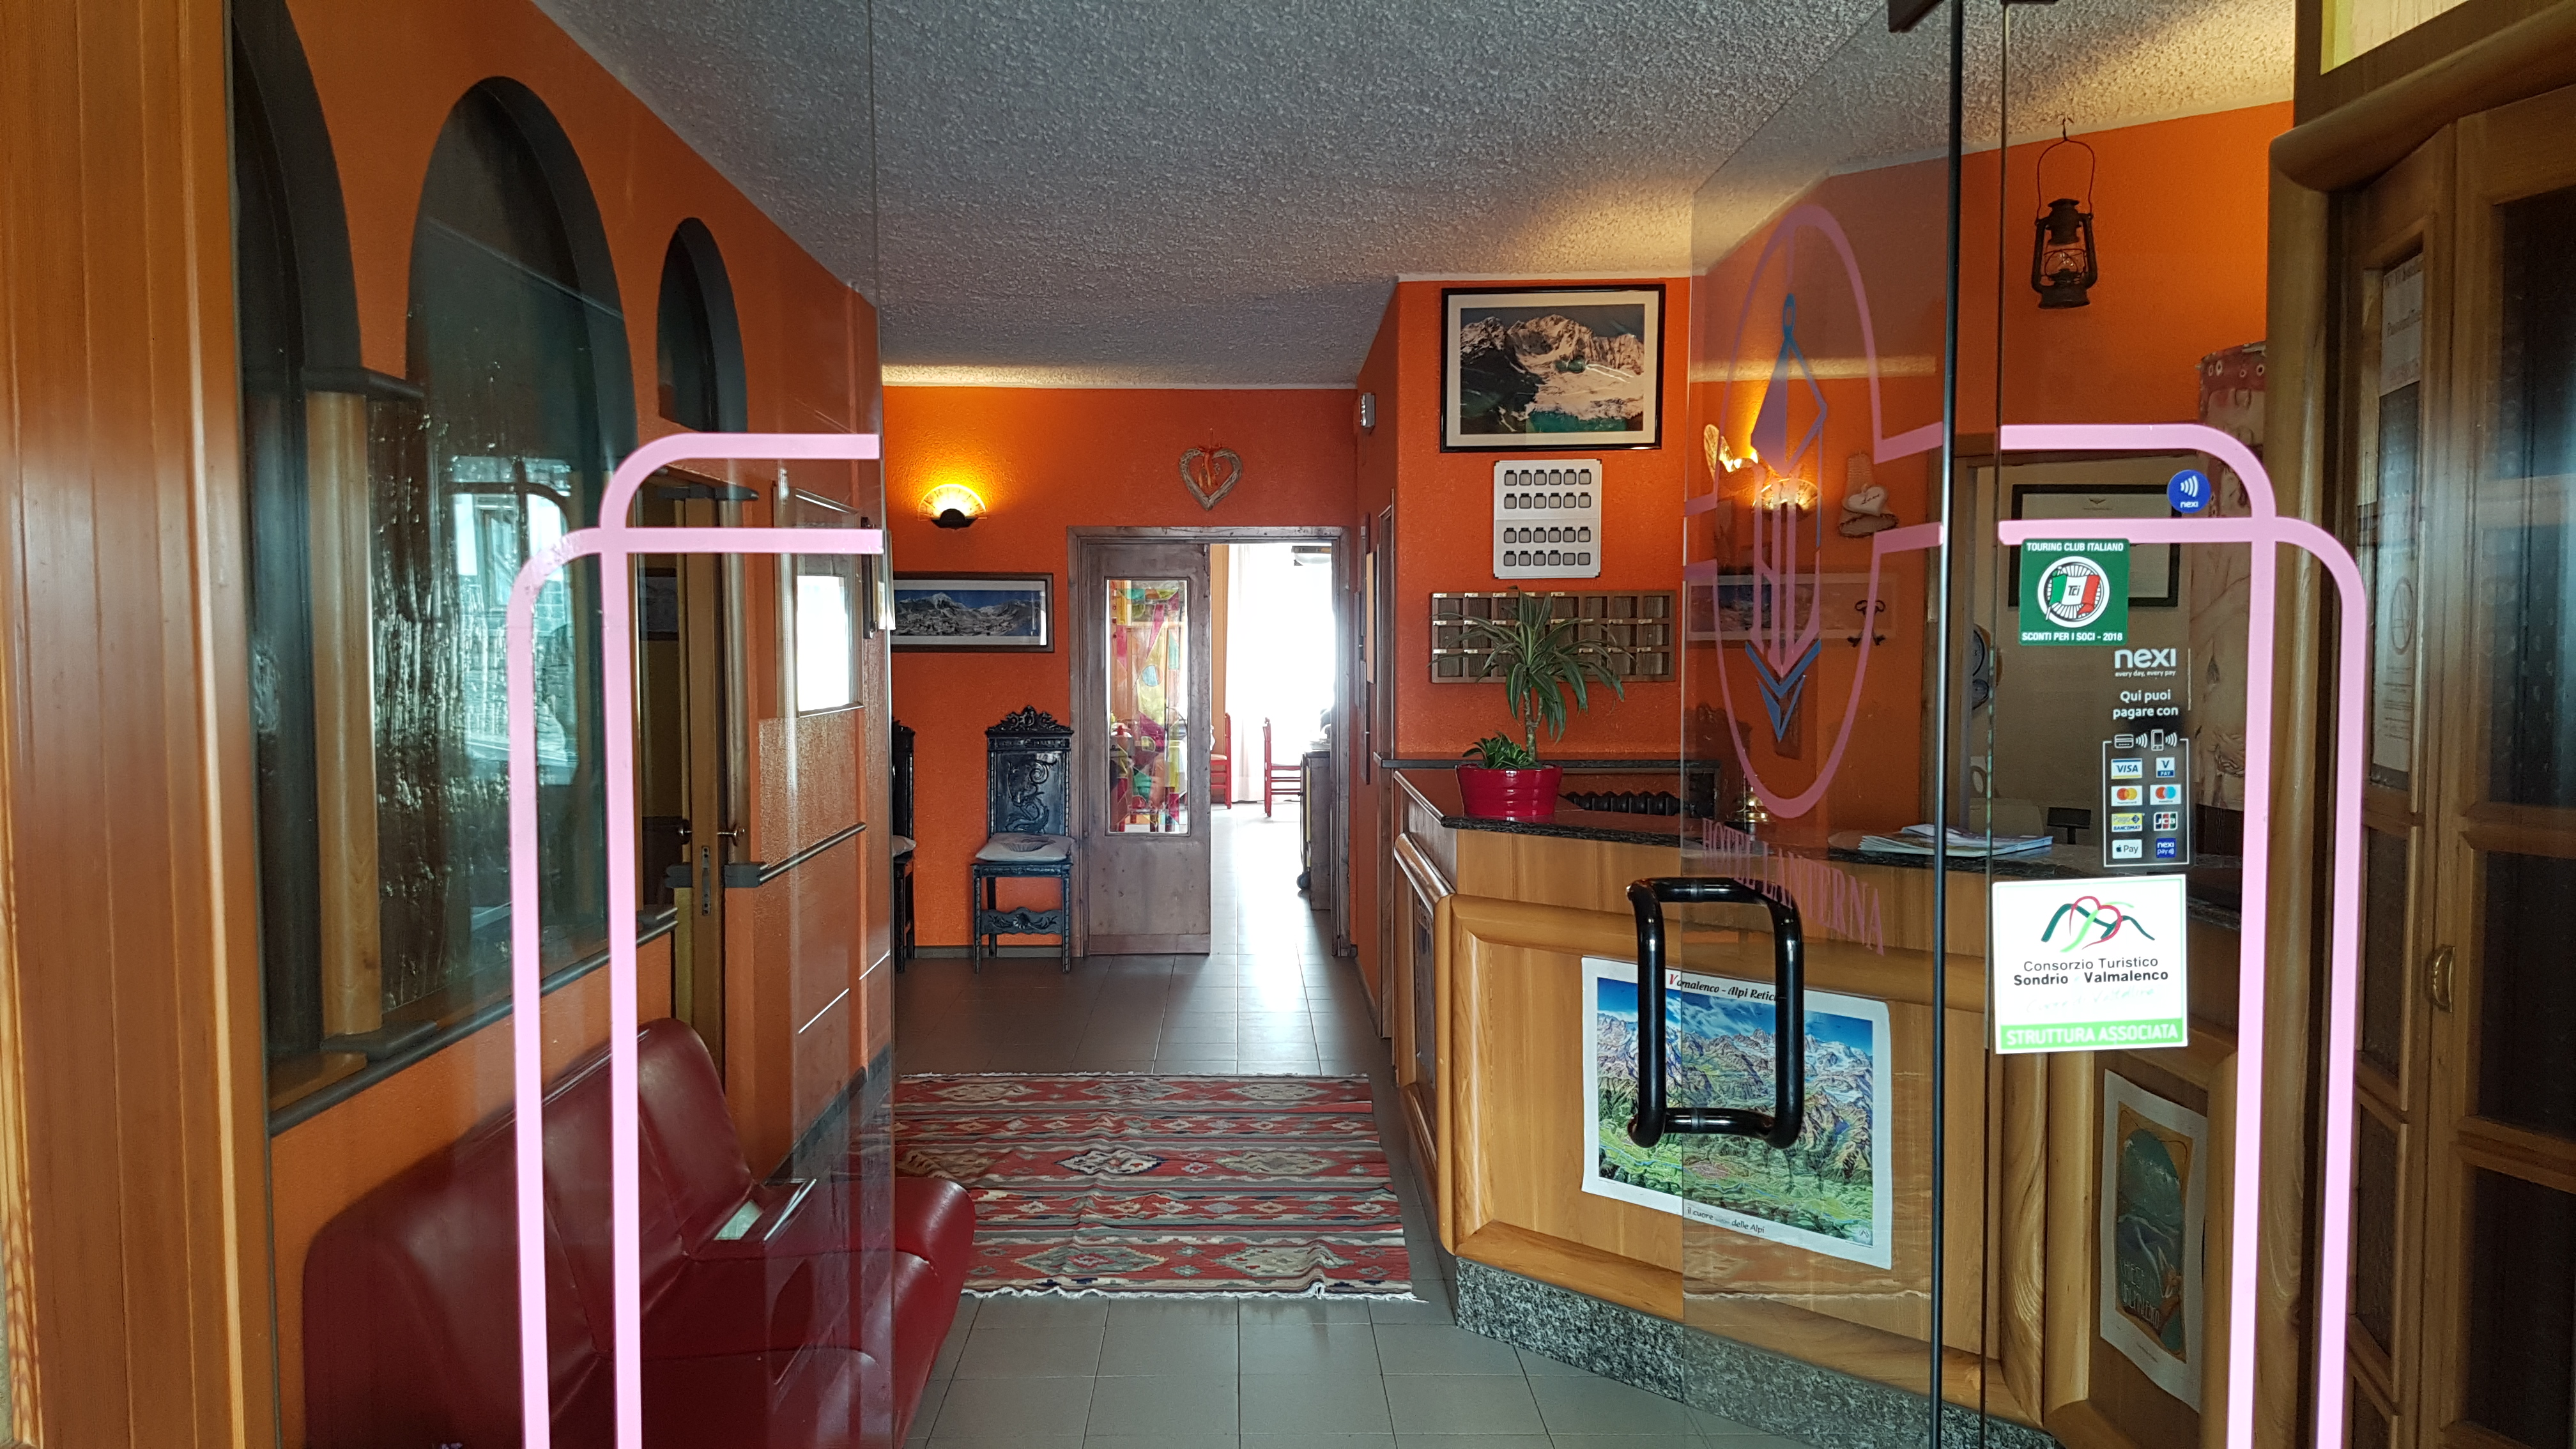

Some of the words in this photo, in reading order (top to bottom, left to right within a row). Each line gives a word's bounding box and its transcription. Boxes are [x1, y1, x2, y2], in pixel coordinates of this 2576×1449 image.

[2180, 500, 2199, 509] nexi
[2027, 542, 2062, 551] TOURING
[2064, 542, 2085, 551] CLUB
[2087, 542, 2124, 551] ITALIANO
[2021, 632, 2052, 641] SCONTI
[2053, 632, 2070, 641] PER
[2076, 632, 2096, 641] SOCI
[2103, 632, 2123, 641] 2018
[2114, 648, 2177, 669] nexi
[2120, 689, 2142, 703] Qui
[2144, 689, 2171, 703] puoi
[2113, 707, 2154, 720] pagare
[2156, 707, 2179, 716] con
[2116, 764, 2138, 773] VISA
[2161, 760, 2170, 769] V
[2123, 845, 2138, 854] Pay
[2023, 959, 2094, 972] Consorzio
[2098, 956, 2159, 969] Turistico
[2013, 973, 2069, 986] Sondrio
[2083, 970, 2168, 983] Valmalenco
[1728, 986, 1749, 999] Alpi
[2006, 1027, 2096, 1046] STRUTTURA
[2098, 1023, 2179, 1041] ASSOCIATA
[1693, 1210, 1713, 1220] cuore
[1731, 1219, 1749, 1229] delle
[1751, 1224, 1765, 1234] Alpi
